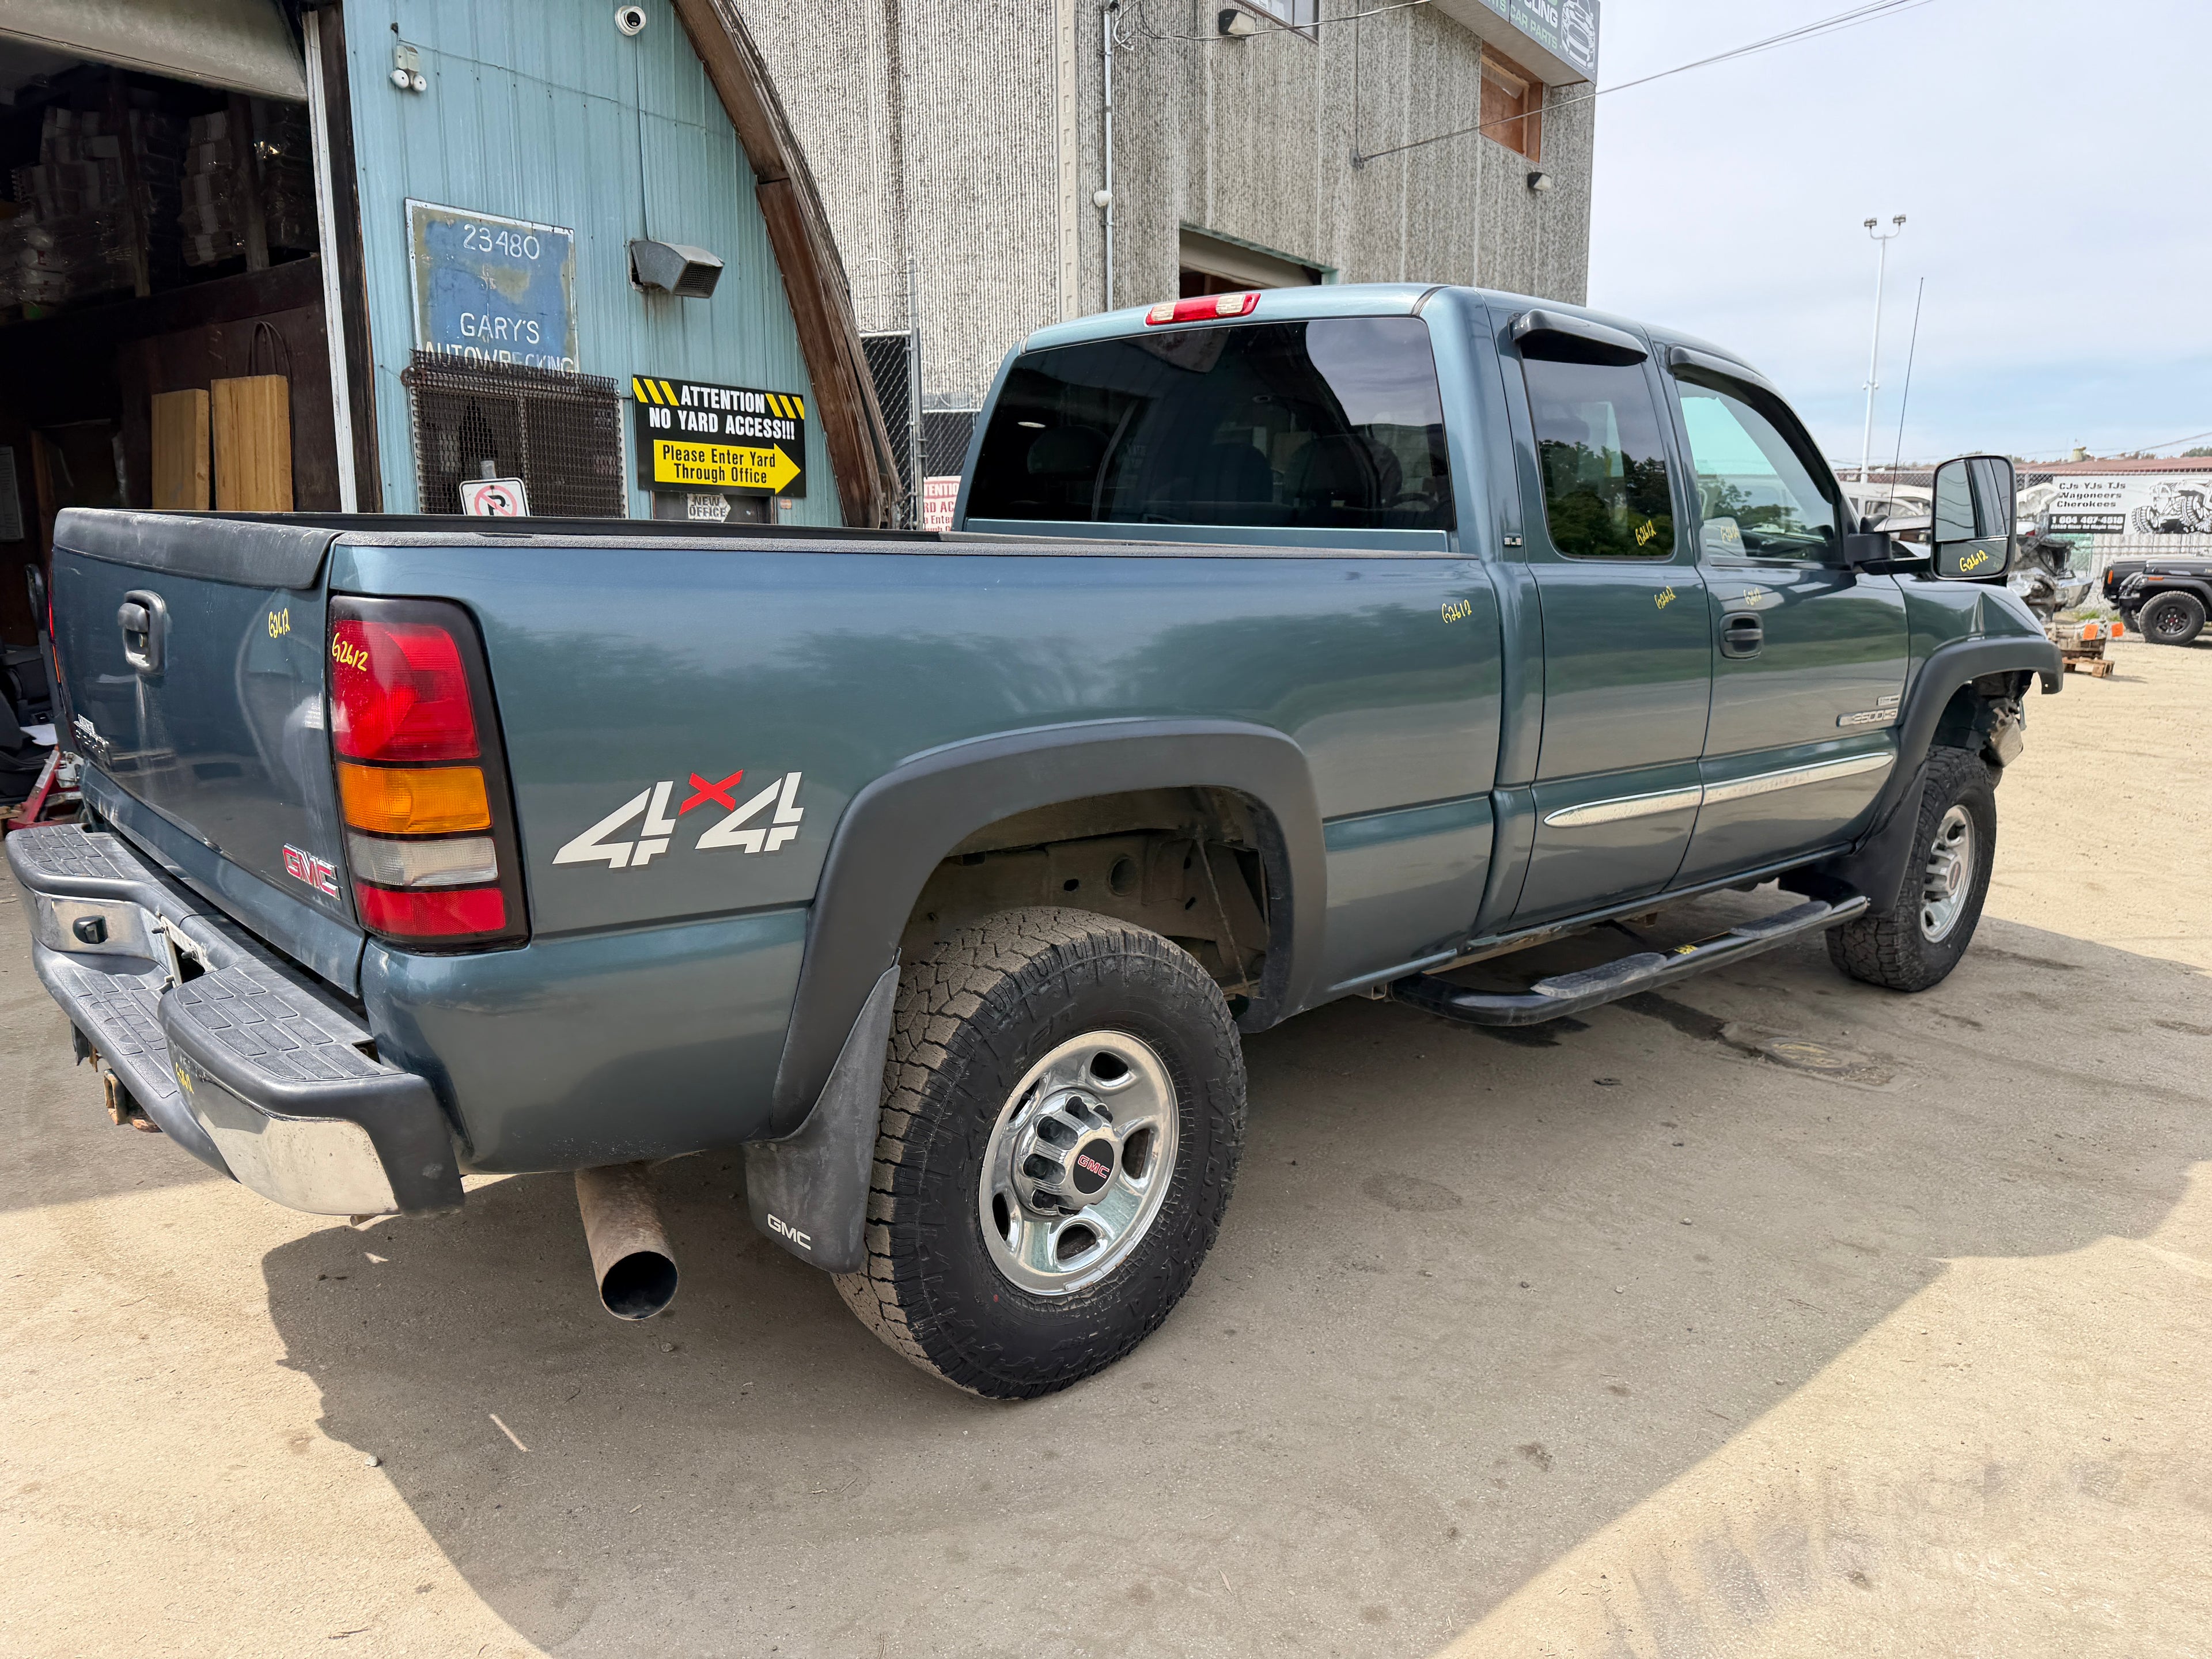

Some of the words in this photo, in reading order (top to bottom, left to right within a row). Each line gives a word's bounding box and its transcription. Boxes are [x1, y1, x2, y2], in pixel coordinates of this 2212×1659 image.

[1510, 5, 1528, 28] CAR
[1531, 20, 1557, 50] PARTS
[463, 224, 540, 260] 23480
[460, 312, 540, 344] GARY'S
[681, 385, 766, 414] ATTENTION
[649, 407, 671, 429] NO
[677, 410, 718, 433] YARD
[725, 414, 795, 440] ACCESS!!!
[663, 444, 705, 462] Please
[711, 448, 744, 465] Enter
[750, 452, 775, 468] Yard
[674, 463, 725, 483] Through
[731, 467, 767, 484] Office
[694, 495, 719, 506] NEW
[1960, 550, 1988, 572] G2612
[1442, 599, 1472, 623] G2612
[332, 632, 369, 672] G2612
[282, 843, 341, 901] GMC
[1078, 1154, 1110, 1179] GMC
[767, 1213, 812, 1251] GMC
